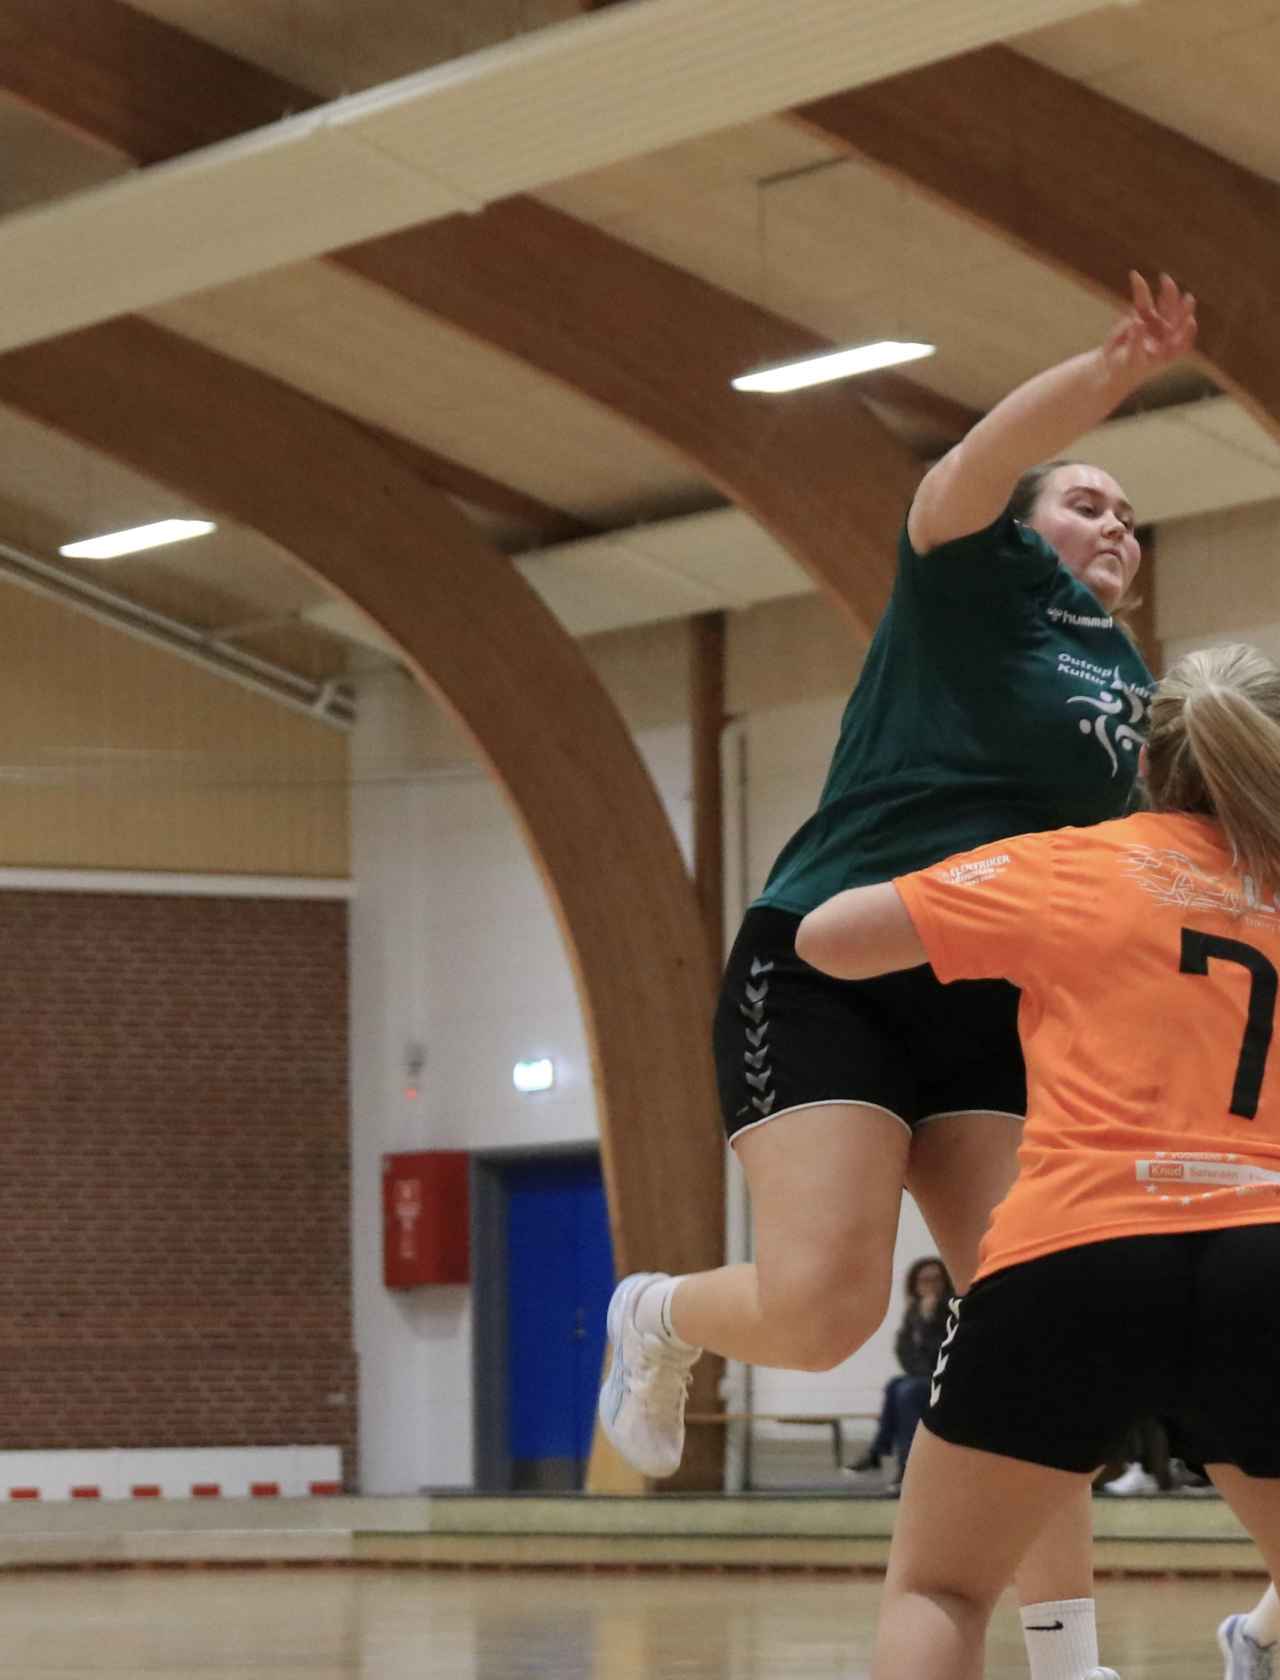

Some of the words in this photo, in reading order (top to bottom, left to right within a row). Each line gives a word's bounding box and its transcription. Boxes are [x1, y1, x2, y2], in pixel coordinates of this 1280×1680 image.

[1063, 609, 1113, 628] hummel
[1057, 663, 1106, 686] Kultur
[1058, 653, 1112, 677] Outrup
[1179, 926, 1279, 1121] 7
